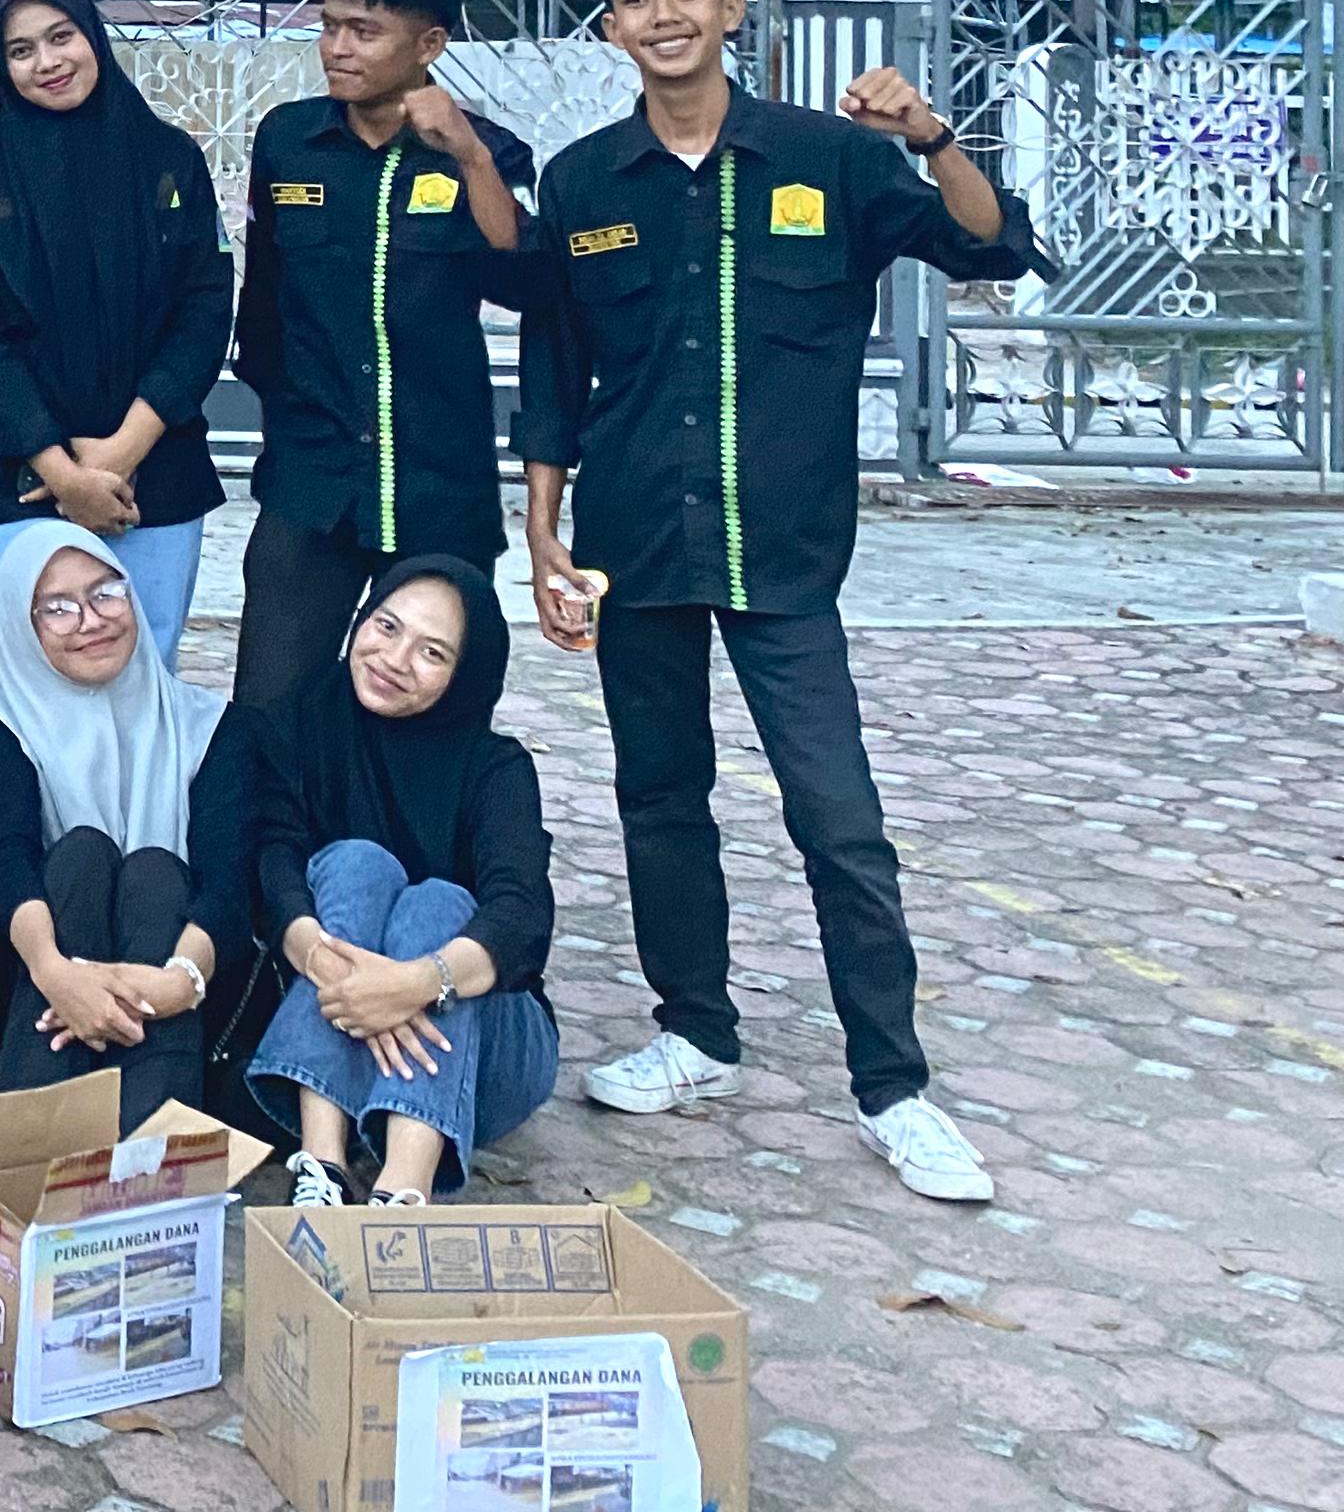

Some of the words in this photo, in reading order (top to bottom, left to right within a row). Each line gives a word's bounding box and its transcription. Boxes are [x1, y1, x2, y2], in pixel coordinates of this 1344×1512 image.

[54, 1229, 161, 1263] PENGGALANGAN
[165, 1222, 200, 1241] DANA
[462, 1370, 593, 1386] PENGGALANGAN
[598, 1369, 642, 1384] DANA
